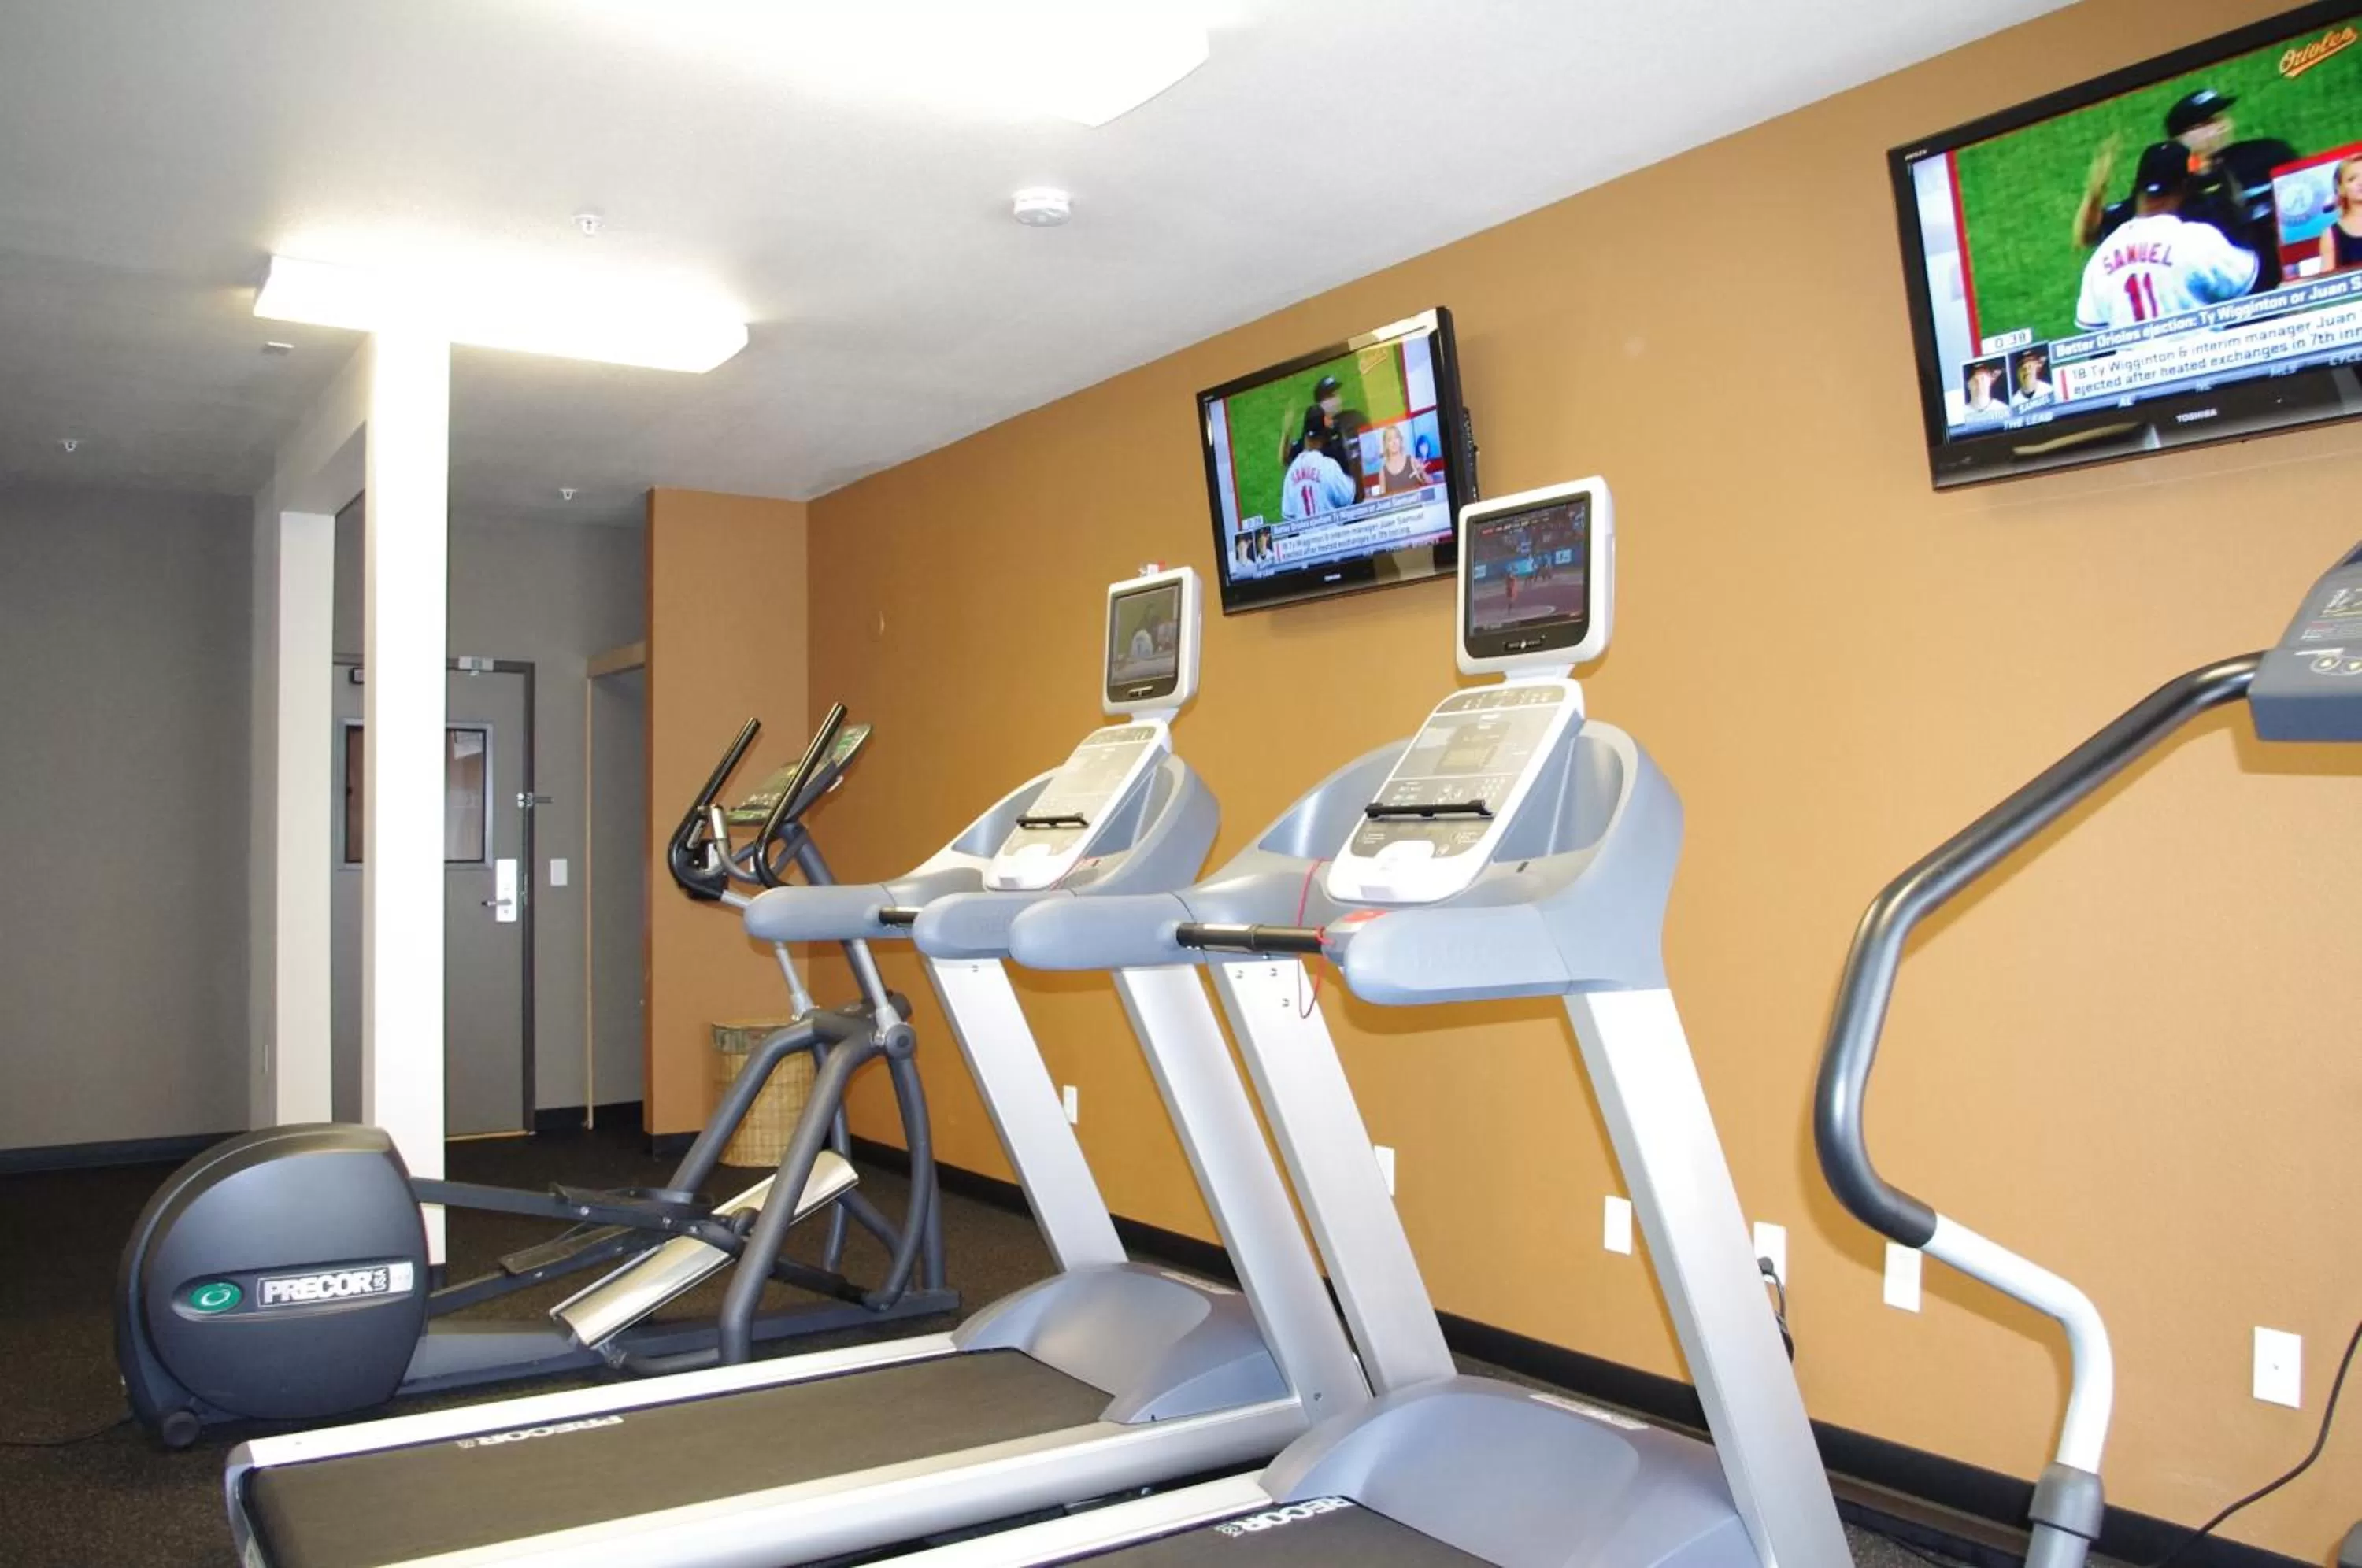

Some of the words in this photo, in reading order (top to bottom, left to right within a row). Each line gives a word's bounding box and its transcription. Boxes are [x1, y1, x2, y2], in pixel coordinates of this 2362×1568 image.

[2103, 242, 2173, 276] SAMUEL
[2096, 329, 2141, 349] Orioles
[2199, 310, 2216, 326] Ty
[2216, 294, 2288, 320] Wigginton
[2290, 290, 2307, 304] or
[2308, 281, 2348, 300] Juan
[2124, 272, 2158, 322] 11
[2074, 375, 2122, 396] ejected
[2126, 369, 2157, 385] after
[2160, 358, 2206, 377] heated
[2210, 342, 2288, 366] exchanges
[2292, 338, 2306, 351] in
[2310, 330, 2334, 346] 7th
[2090, 364, 2105, 378] Ty
[2109, 351, 2175, 372] Wigginton
[2192, 337, 2241, 354] interim
[2245, 321, 2311, 343] manager
[2316, 312, 2356, 329] Juan
[2175, 407, 2219, 423] TOSHIBA
[264, 1271, 373, 1304] PRECOR
